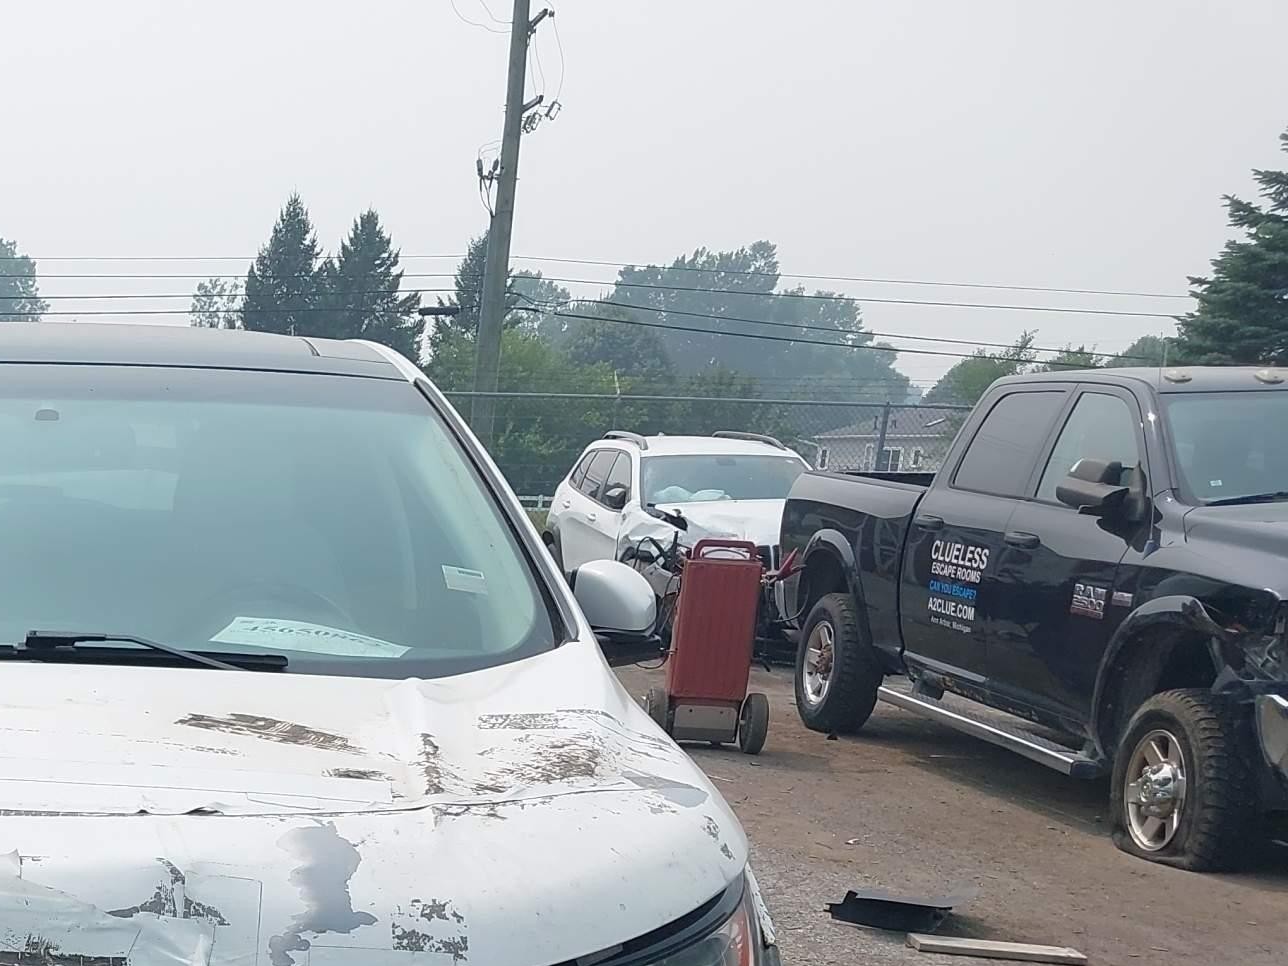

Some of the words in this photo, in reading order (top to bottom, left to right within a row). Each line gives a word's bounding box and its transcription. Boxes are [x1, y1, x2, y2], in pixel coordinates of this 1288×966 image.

[931, 540, 989, 570] CLUELESS
[931, 562, 957, 579] ESCAPE
[956, 567, 982, 584] ROOMS
[930, 580, 941, 592] CAN
[941, 582, 952, 594] YOU
[952, 585, 977, 600] ESCAPE?
[1073, 583, 1107, 601] RAM
[928, 597, 975, 621] A2CLUE.COM
